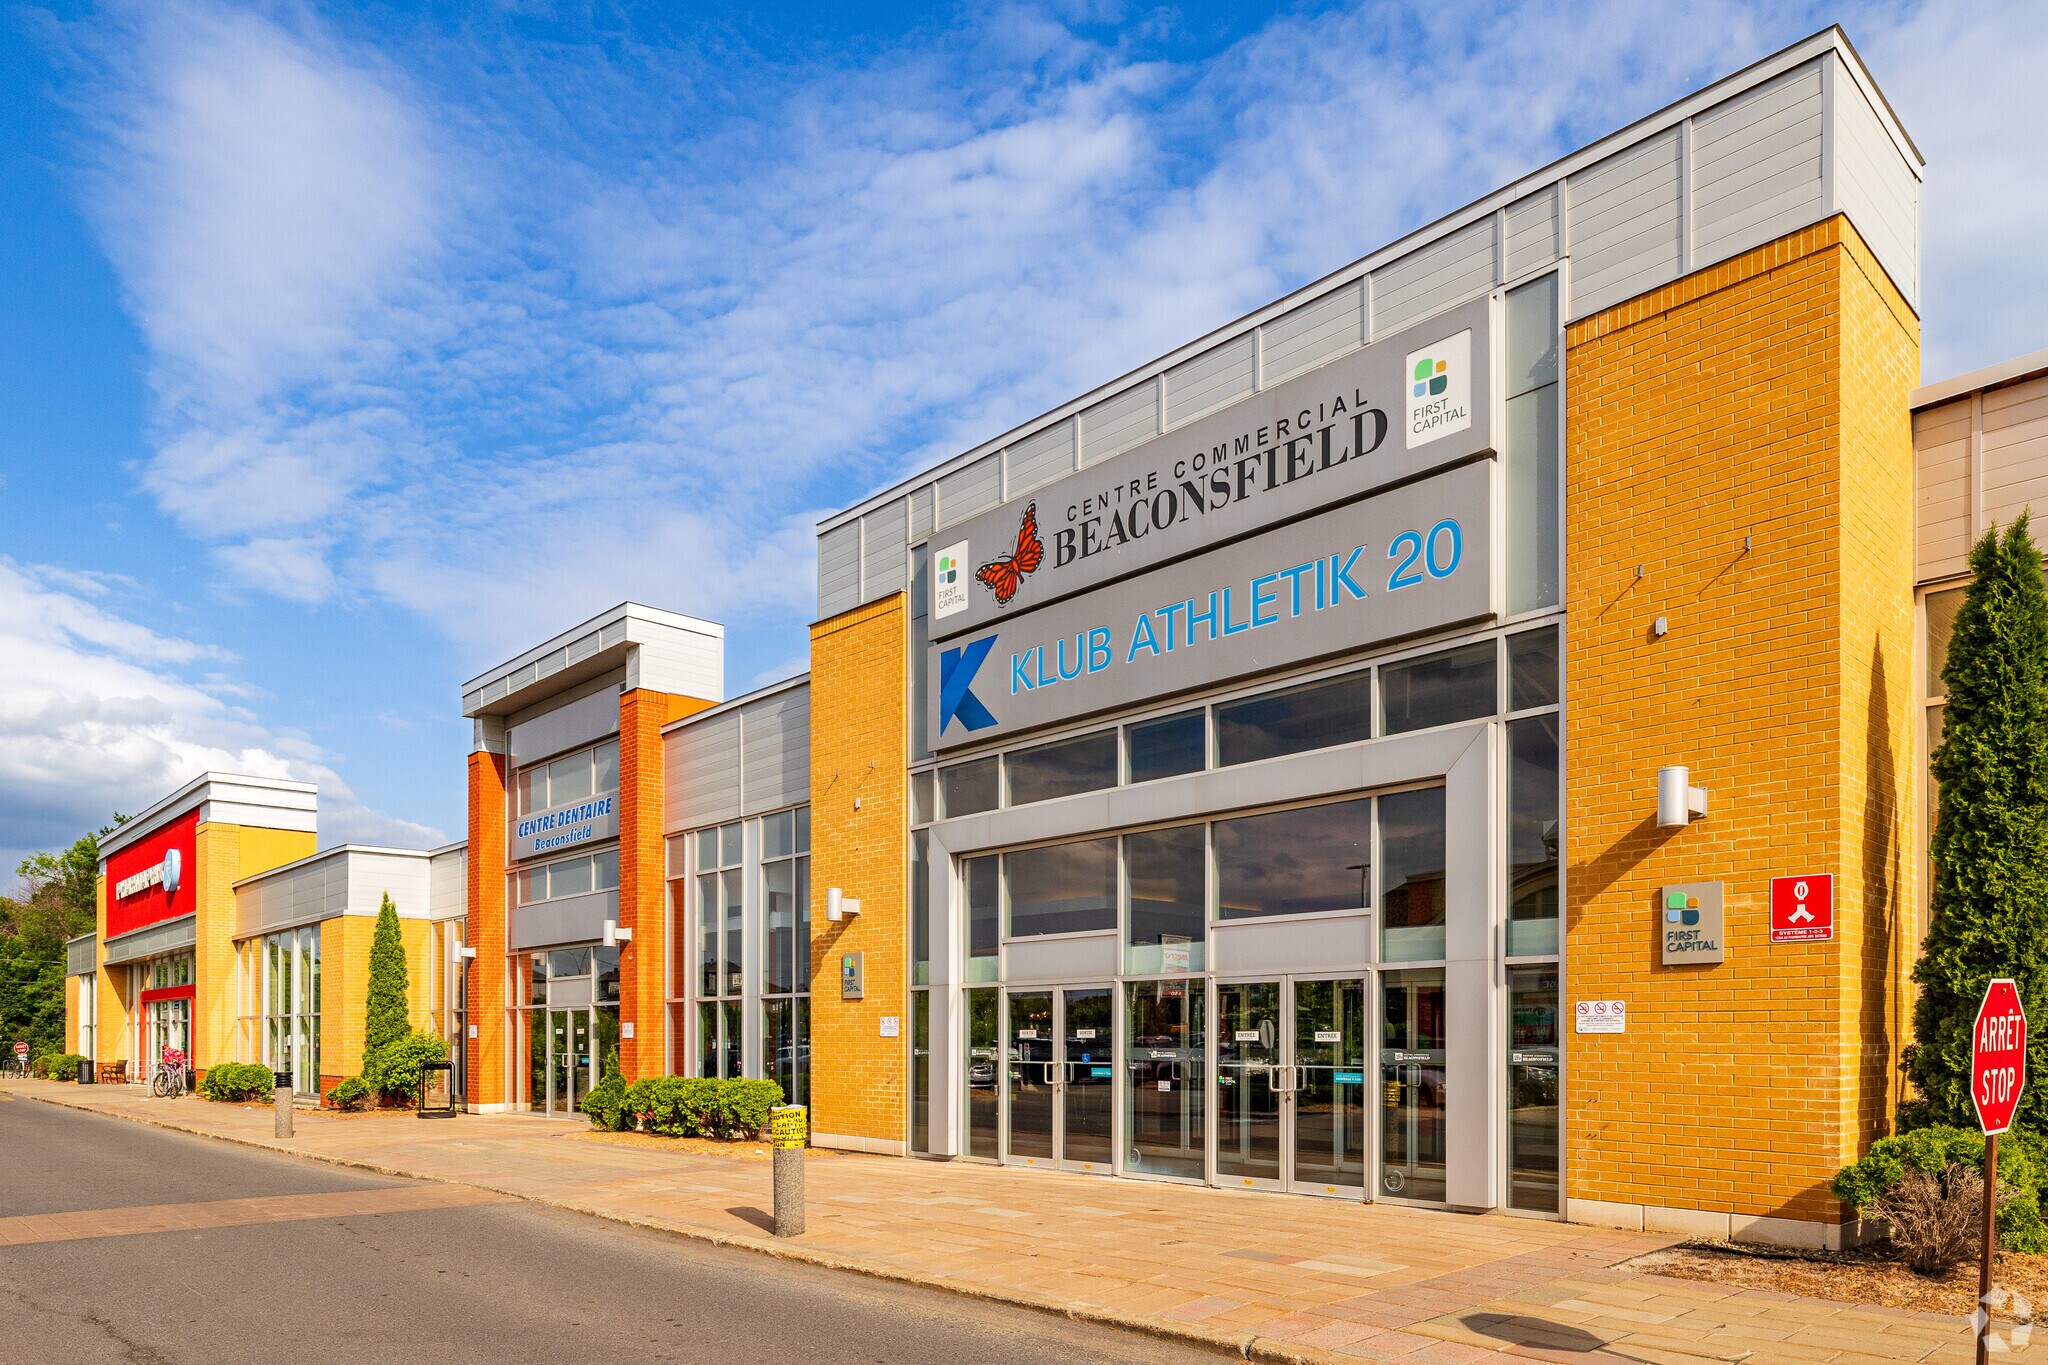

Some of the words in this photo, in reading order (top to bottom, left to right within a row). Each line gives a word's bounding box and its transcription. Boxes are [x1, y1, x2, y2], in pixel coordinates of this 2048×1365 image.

[1413, 397, 1449, 421] FIRST
[1413, 406, 1467, 434] CAPITAL
[1067, 470, 1158, 521] CENTRE
[1174, 388, 1369, 480] COMMERCIAL
[1053, 407, 1389, 569] BEACONSFIELD
[938, 576, 957, 600] FIRST
[938, 593, 966, 610] CAPITAL
[1010, 625, 1113, 696] KLUB
[1126, 545, 1370, 664] ATHLETIK
[1386, 518, 1463, 593] 20
[517, 813, 555, 838] CENTRE
[557, 797, 612, 828] DENTAIRE
[534, 823, 592, 851] Beaconsfield
[1666, 940, 1718, 953] CAPITAL
[1667, 929, 1701, 941] FIRST
[1979, 1008, 2022, 1053] ARRÊT
[1981, 1066, 2015, 1106] STOP
